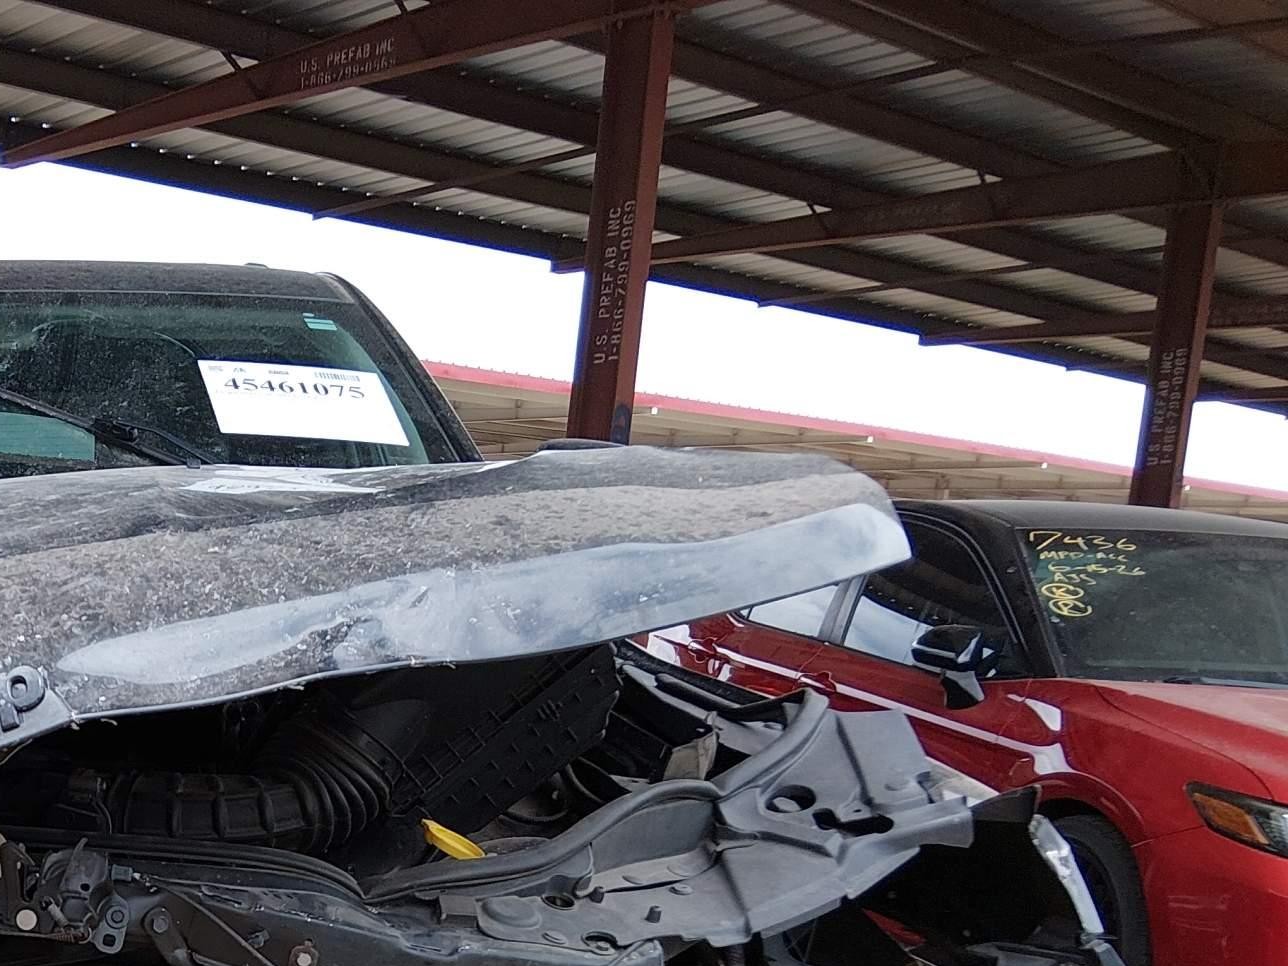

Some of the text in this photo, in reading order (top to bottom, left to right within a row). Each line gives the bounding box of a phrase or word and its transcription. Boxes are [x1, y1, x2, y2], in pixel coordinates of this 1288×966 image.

[326, 42, 371, 67] PREFAB
[598, 246, 618, 319] PREFAB
[223, 376, 365, 399] 45461075
[1029, 530, 1137, 551] 7436
